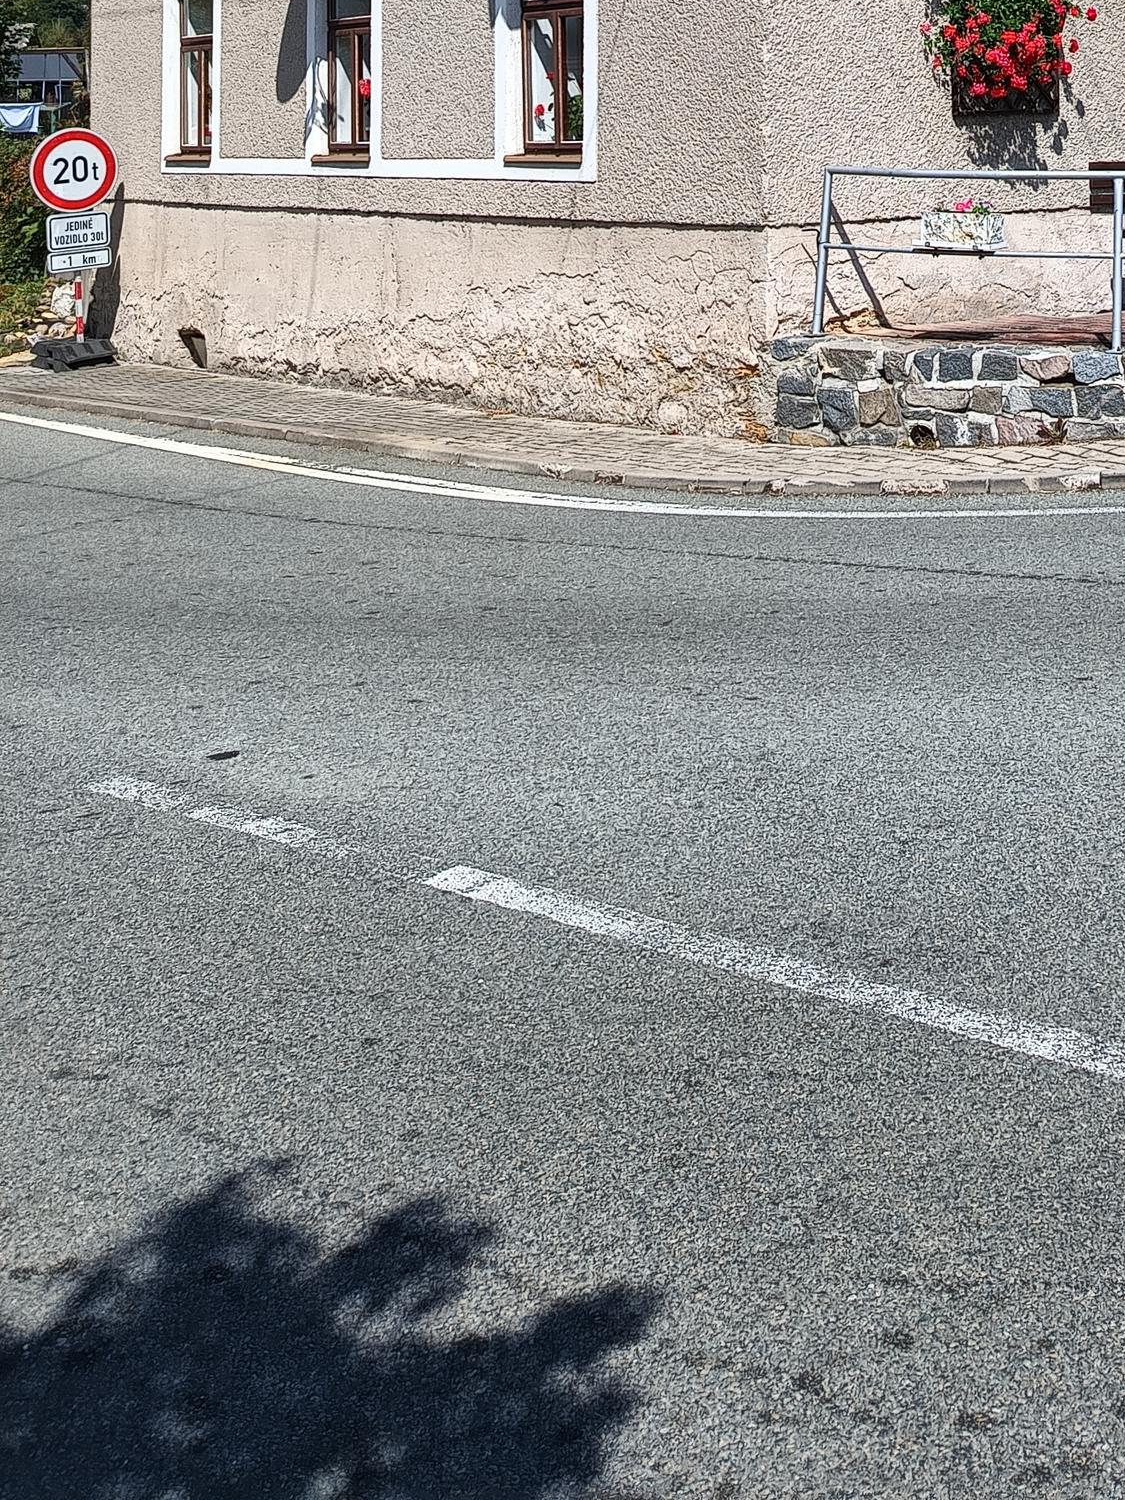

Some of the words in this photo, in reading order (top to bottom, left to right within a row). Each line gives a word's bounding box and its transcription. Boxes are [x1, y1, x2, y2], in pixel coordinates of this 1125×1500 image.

[64, 219, 93, 232] JEDINÉ
[55, 234, 89, 246] VOZIDLO
[90, 232, 104, 242] 30t
[82, 253, 97, 265] km
